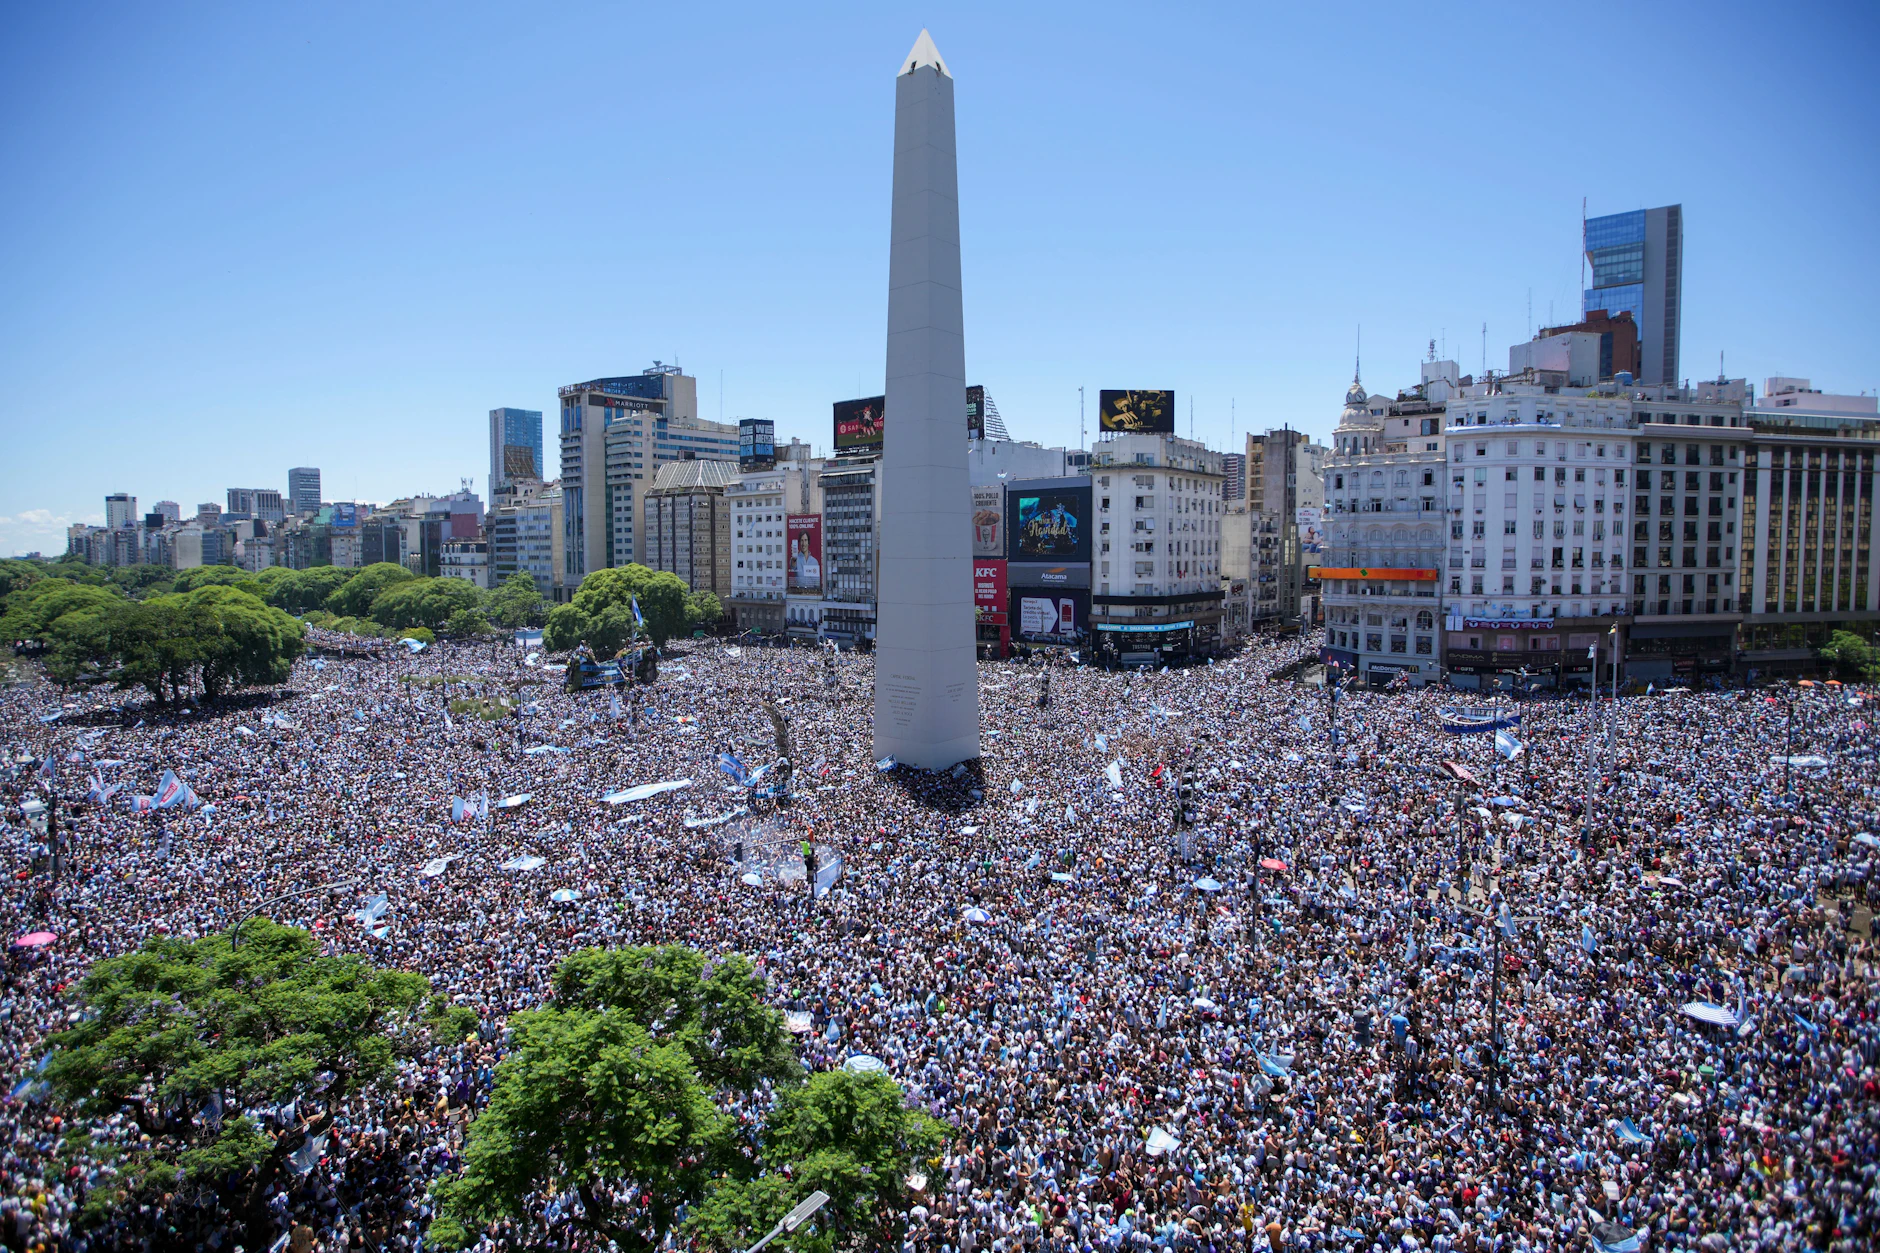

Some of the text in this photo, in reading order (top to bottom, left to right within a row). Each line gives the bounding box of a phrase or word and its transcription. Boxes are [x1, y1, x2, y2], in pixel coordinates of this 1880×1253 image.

[616, 400, 649, 409] MARRIOTT
[740, 425, 754, 436] WE
[756, 424, 773, 434] WE
[1028, 520, 1068, 536] Navidad
[975, 568, 997, 578] KFC
